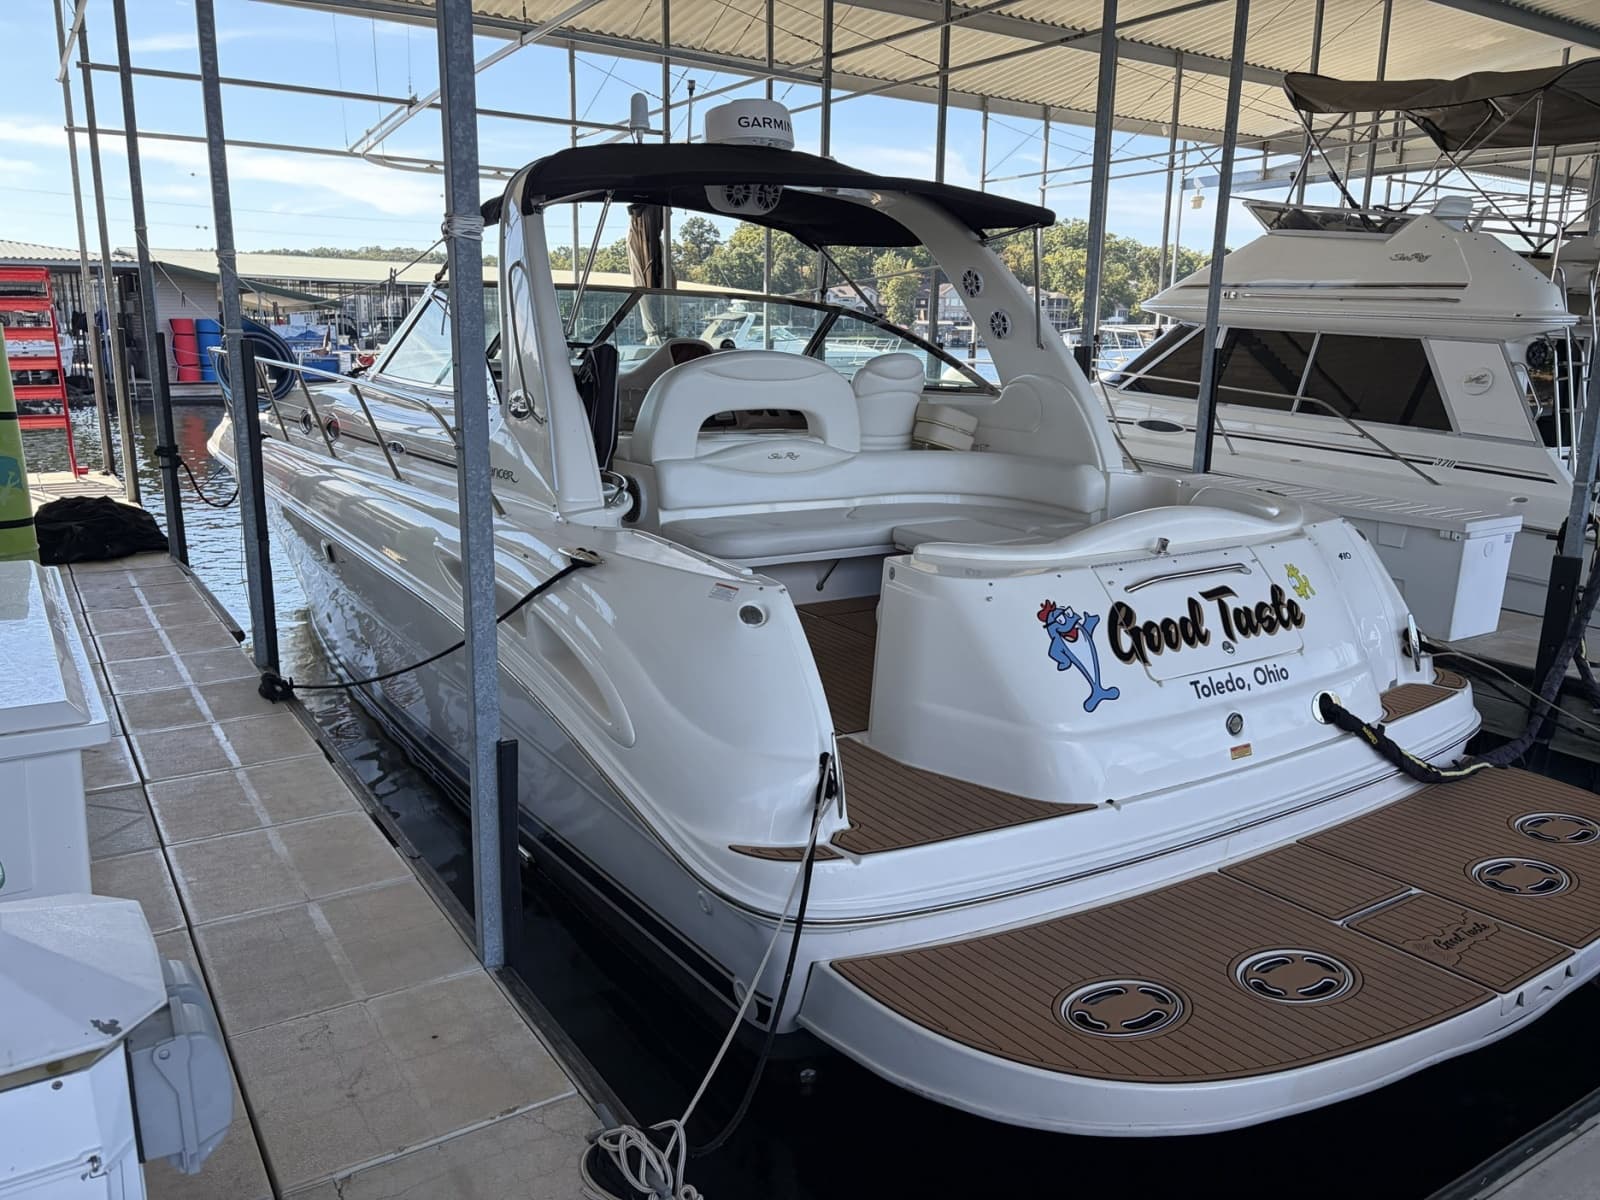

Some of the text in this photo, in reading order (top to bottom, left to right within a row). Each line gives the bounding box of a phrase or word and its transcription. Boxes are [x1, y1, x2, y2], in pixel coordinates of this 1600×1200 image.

[737, 116, 793, 133] GARMIN
[1433, 458, 1456, 468] 370
[1338, 551, 1352, 561] 410
[1107, 583, 1306, 667] Good Taste
[1189, 663, 1290, 700] Toledo, Ohio
[1432, 921, 1491, 951] Good Taste
